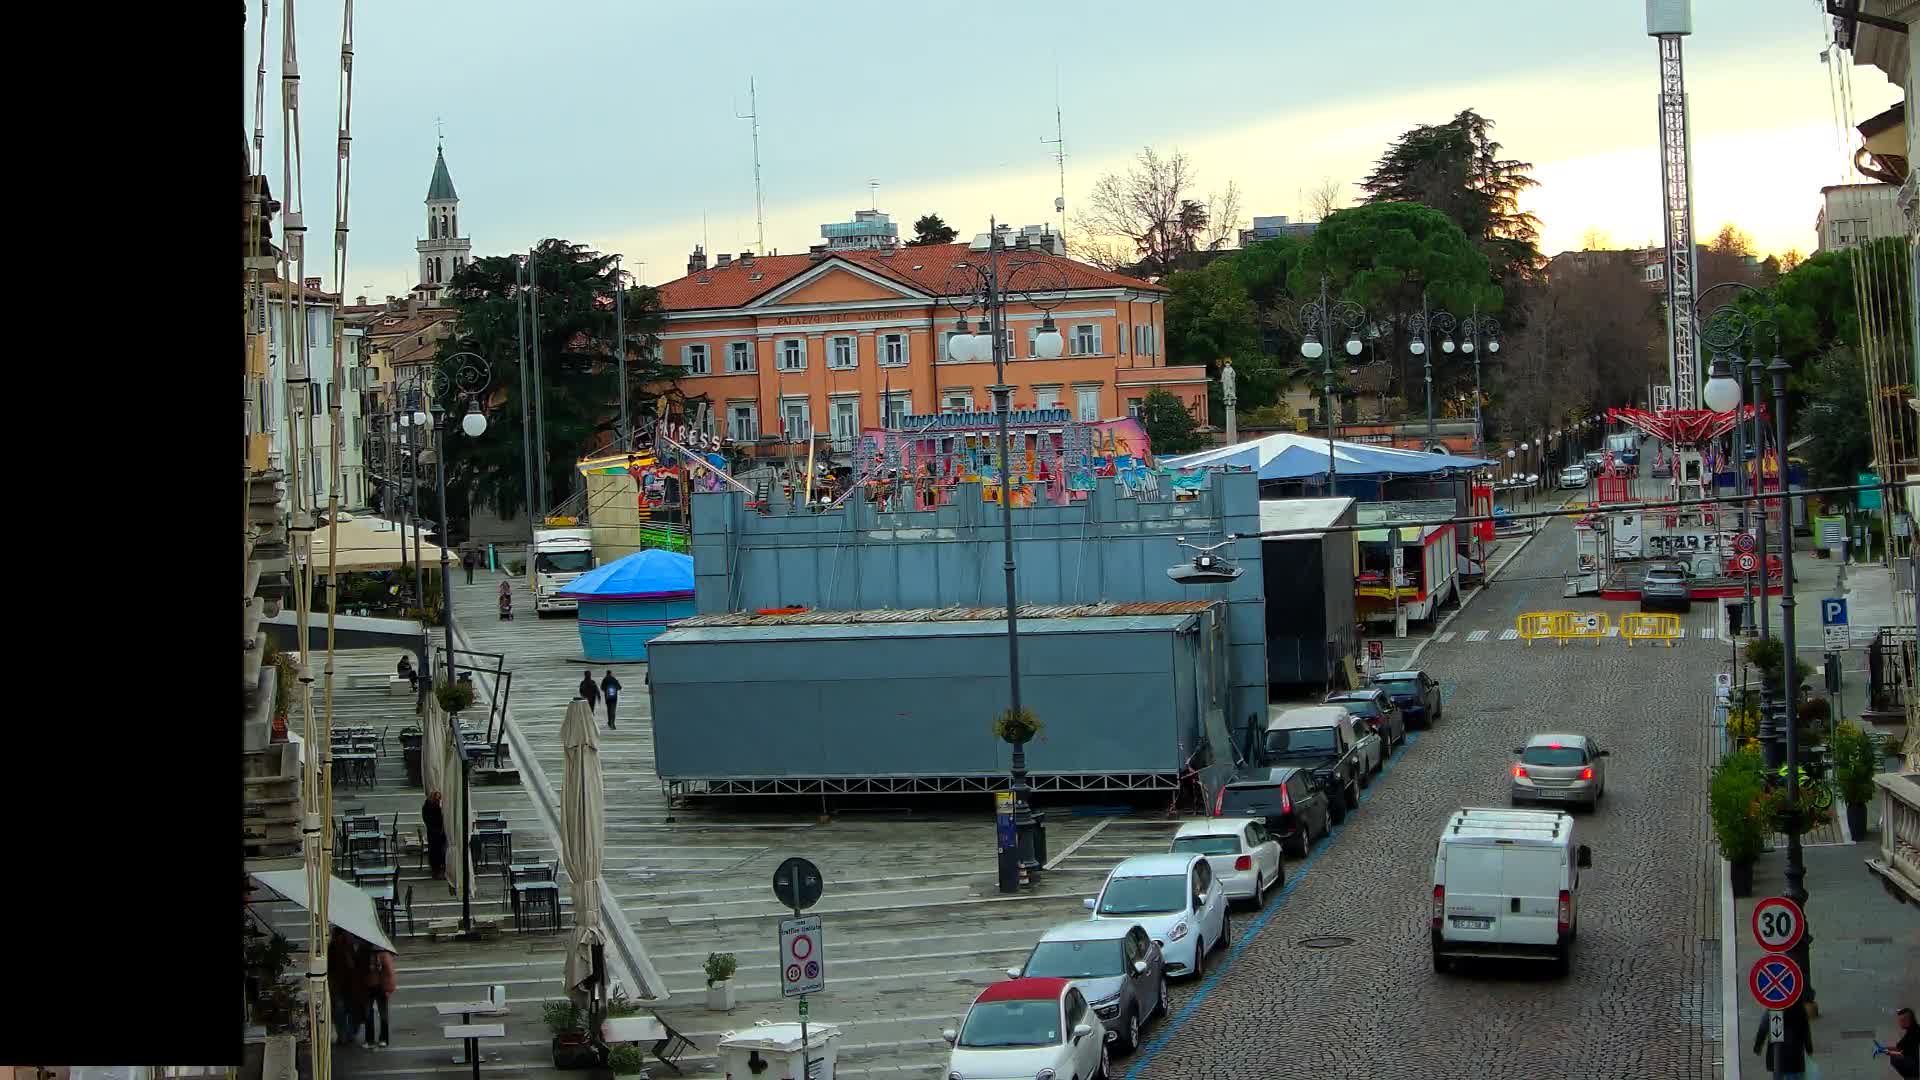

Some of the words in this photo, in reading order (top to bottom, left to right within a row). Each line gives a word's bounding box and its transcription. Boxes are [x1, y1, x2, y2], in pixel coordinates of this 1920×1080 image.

[1743, 557, 1752, 567] 20
[1827, 602, 1841, 622] P
[1762, 911, 1791, 937] 30
